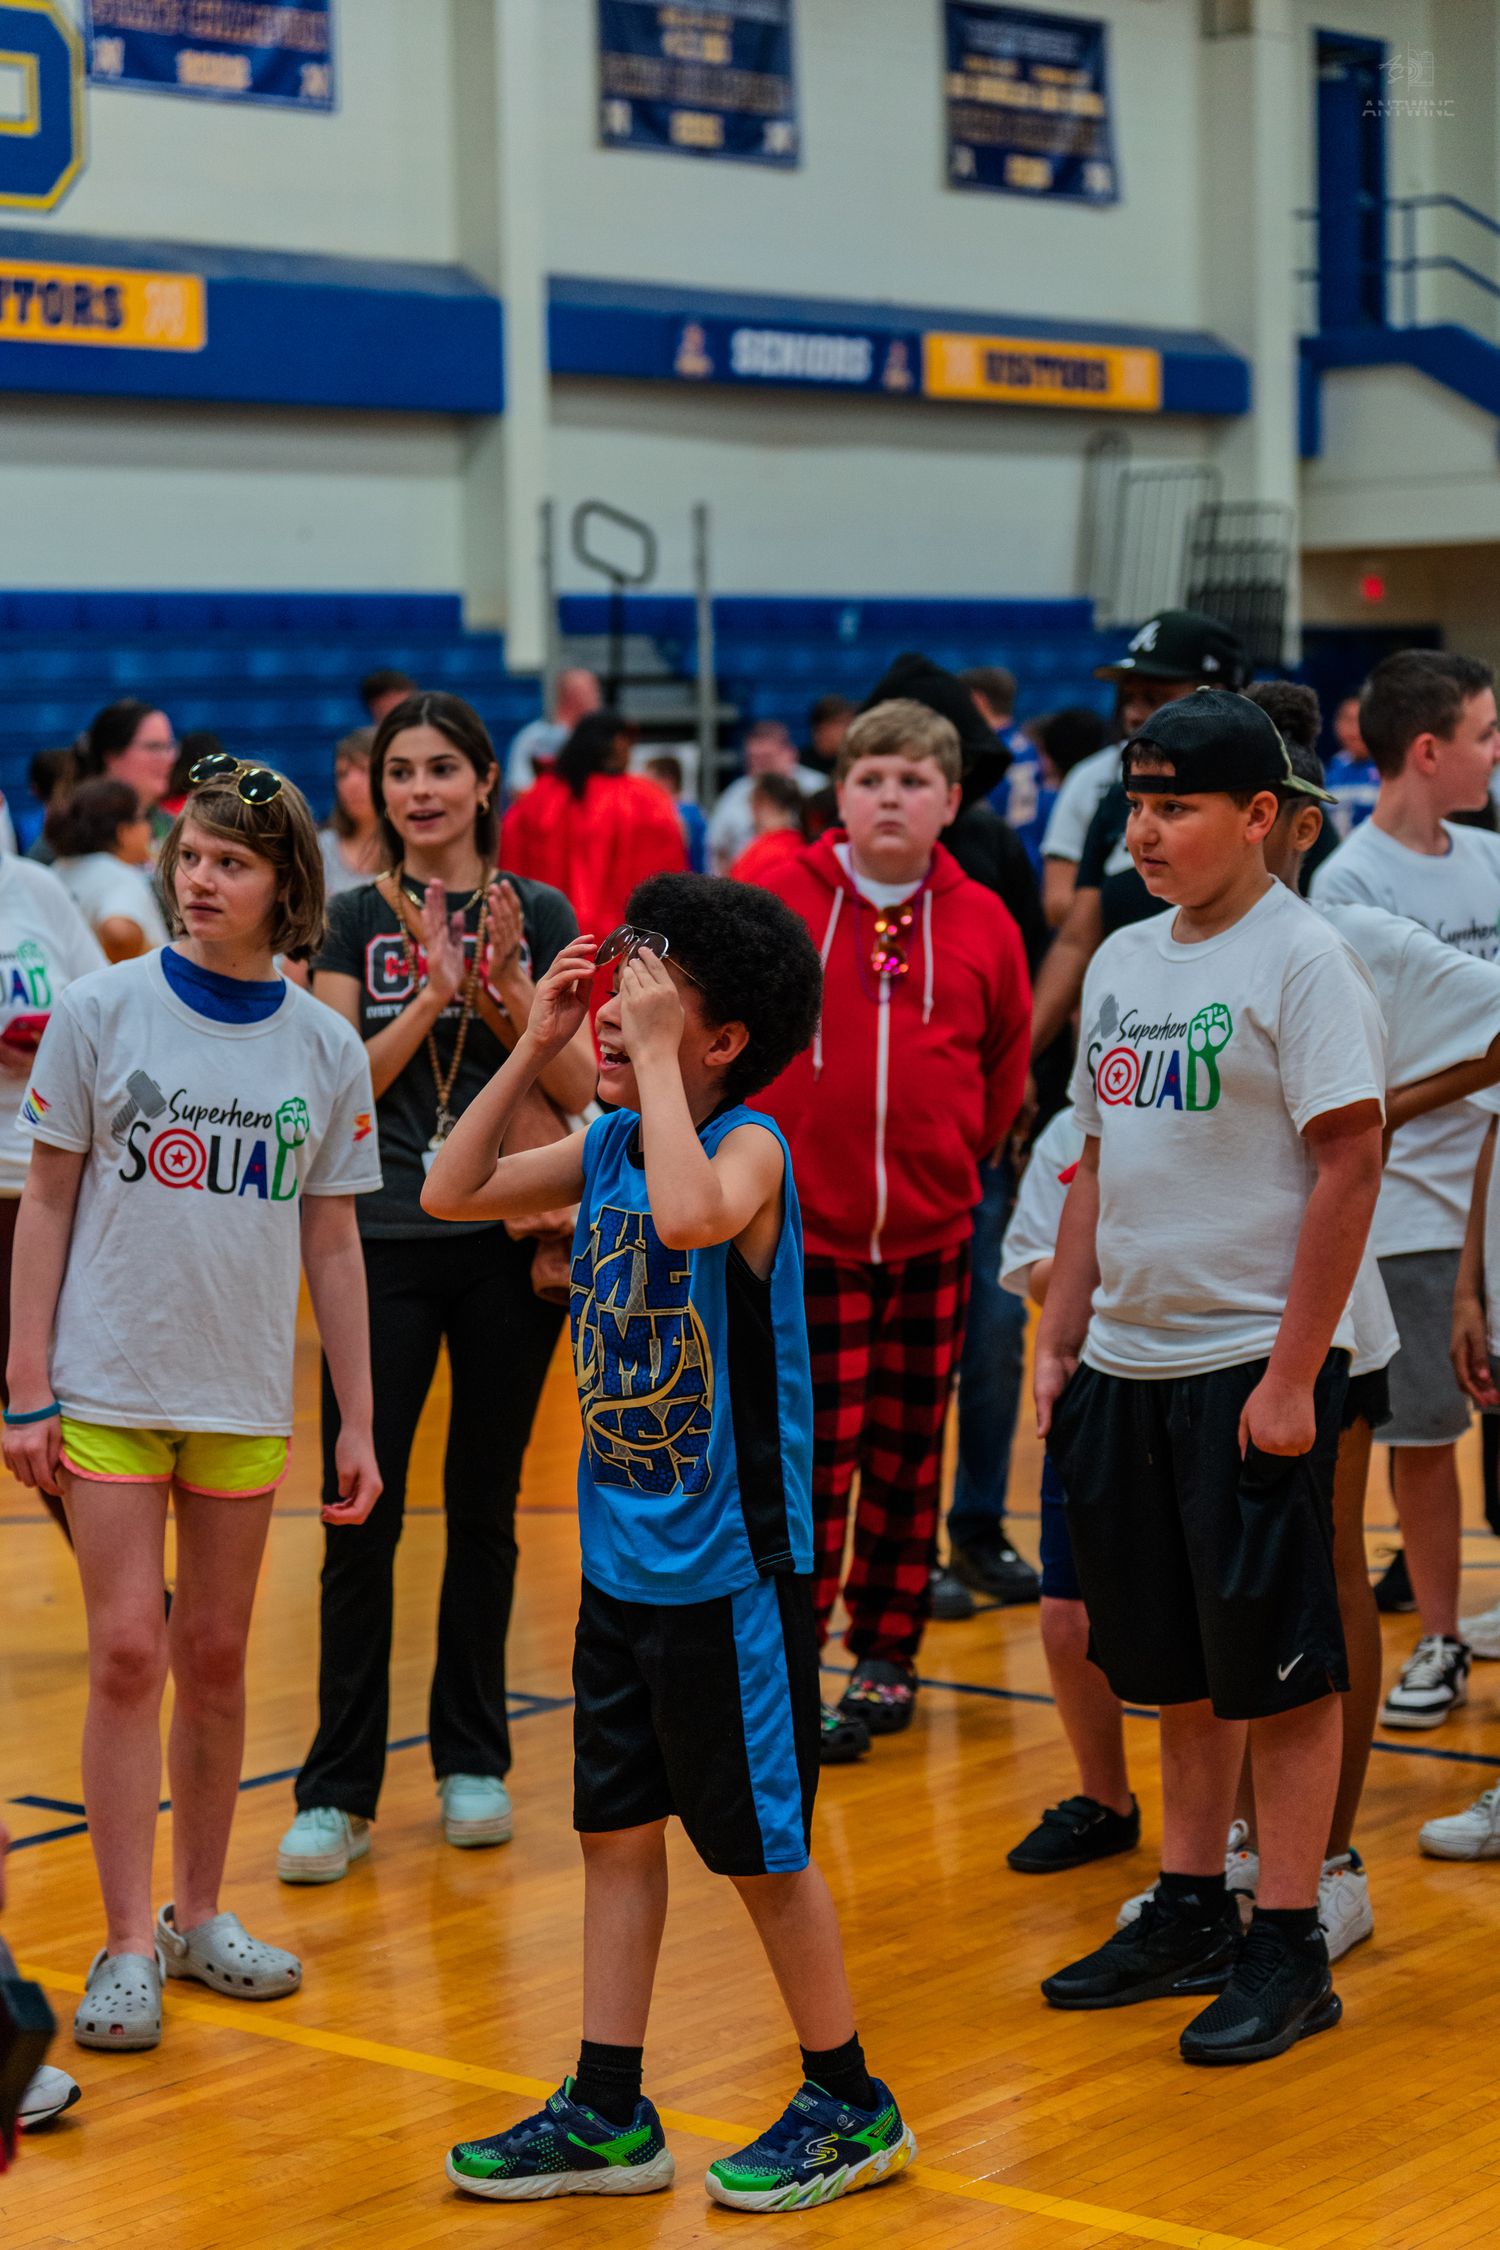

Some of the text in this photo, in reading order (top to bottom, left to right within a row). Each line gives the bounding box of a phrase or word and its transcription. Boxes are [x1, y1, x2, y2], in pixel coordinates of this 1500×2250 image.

[1116, 1009, 1188, 1050] Superhero
[1087, 1038, 1221, 1112] SQUAD
[168, 1088, 273, 1132] Superhero
[118, 1118, 301, 1201] SQUAD
